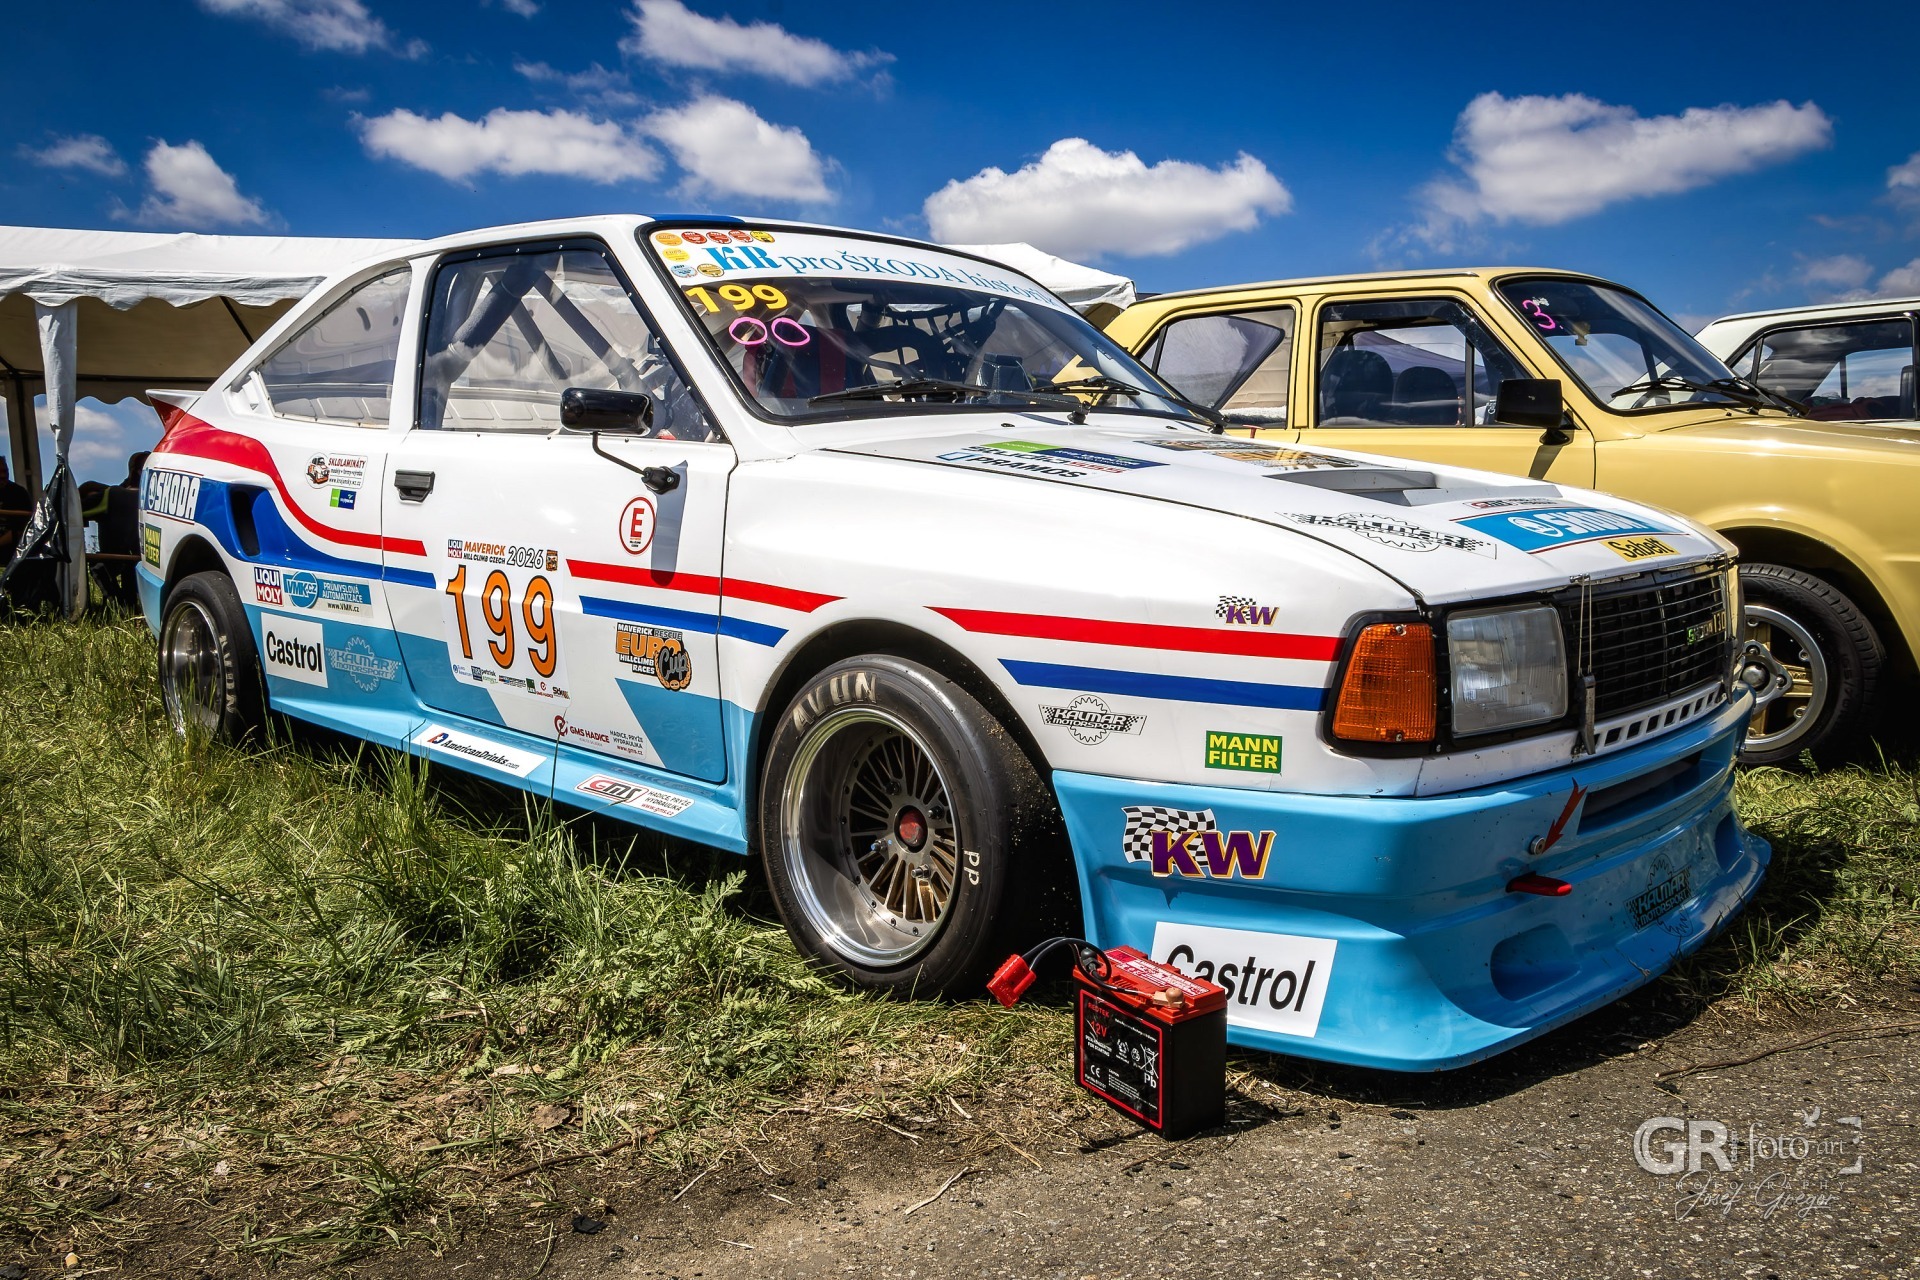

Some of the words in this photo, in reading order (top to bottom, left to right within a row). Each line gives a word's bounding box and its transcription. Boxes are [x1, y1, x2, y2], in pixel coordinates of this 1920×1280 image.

[773, 255, 843, 274] pro
[836, 249, 966, 284] ŠKODA
[686, 285, 788, 313] 199
[966, 457, 1087, 478] PRAMOS
[631, 507, 645, 537] E
[145, 527, 161, 547] MANN
[463, 553, 474, 561] HILL
[464, 541, 507, 556] MAVERICK
[507, 545, 544, 569] 2026
[1608, 537, 1674, 559] Sabelt
[255, 568, 280, 586] LIQUI
[256, 585, 282, 604] MOLY
[322, 590, 363, 603] AUTOMATIZACE
[323, 581, 360, 595] PRŮMYSLOVÁ
[327, 602, 360, 612] www.VMK.cz
[1225, 605, 1279, 626] KW
[446, 564, 557, 678] 199
[617, 623, 653, 636] MAVERICK
[653, 629, 683, 641] RESCUE
[266, 630, 323, 673] Castrol
[336, 651, 390, 670] KALMAR
[620, 654, 655, 666] HILLCLIMB
[335, 661, 389, 678] MOTORSPORT
[632, 664, 656, 675] RACES
[658, 648, 689, 680] Cup
[793, 671, 878, 733] AVON
[1052, 718, 1126, 731] MOTORSPORT
[1053, 708, 1128, 726] KALMAR
[569, 726, 585, 737] GMS
[585, 729, 610, 744] HADICE
[1209, 734, 1279, 753] MANN
[440, 739, 520, 770] AmericanDrinks.com
[1208, 751, 1278, 769] FILTER
[1151, 830, 1277, 880] KW
[964, 850, 980, 886] PP
[1637, 873, 1687, 914] KALMAR
[1639, 889, 1691, 927] MOTORSPORT
[1090, 1020, 1107, 1038] 12V
[1144, 1072, 1157, 1089] Pb
